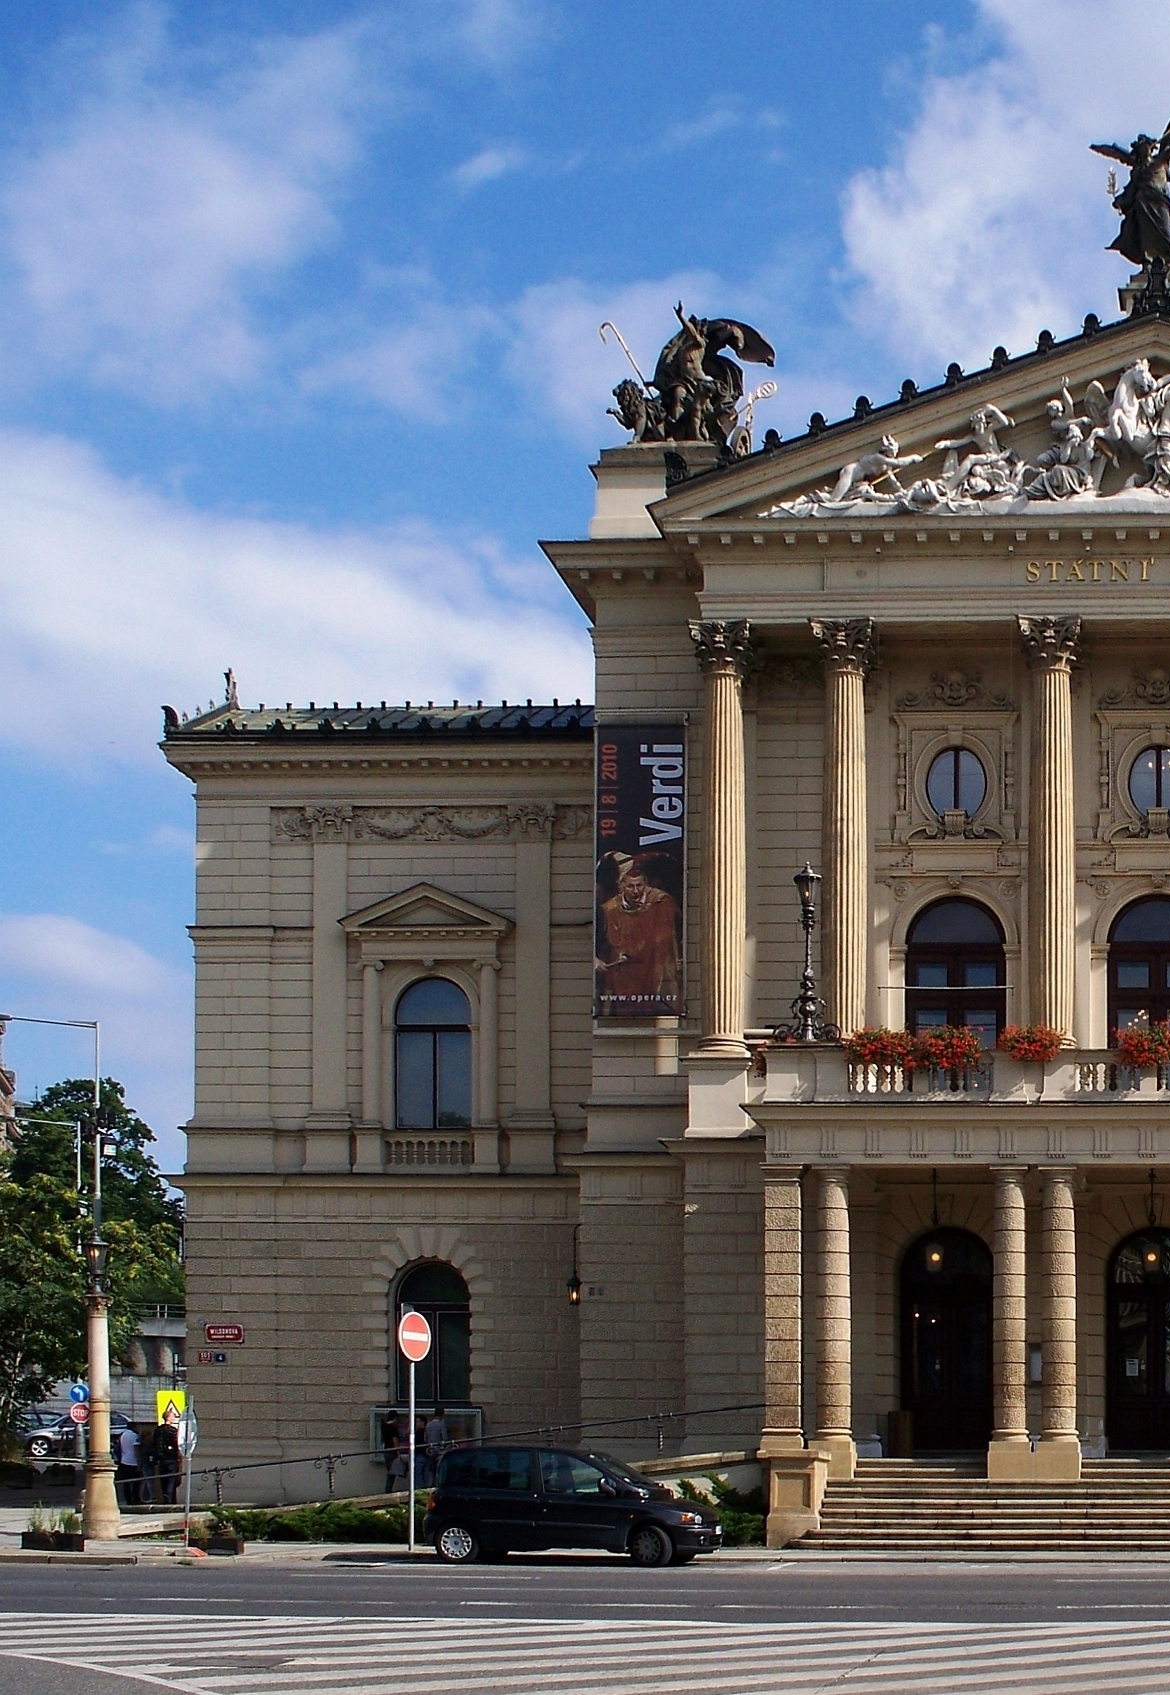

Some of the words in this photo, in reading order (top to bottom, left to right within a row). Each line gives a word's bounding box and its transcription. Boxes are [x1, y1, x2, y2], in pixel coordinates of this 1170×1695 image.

[601, 744, 617, 781] 2010
[601, 795, 617, 805] 8
[639, 744, 683, 846] Verdi
[601, 819, 617, 837] 19
[600, 994, 677, 1003] www.opera.cz
